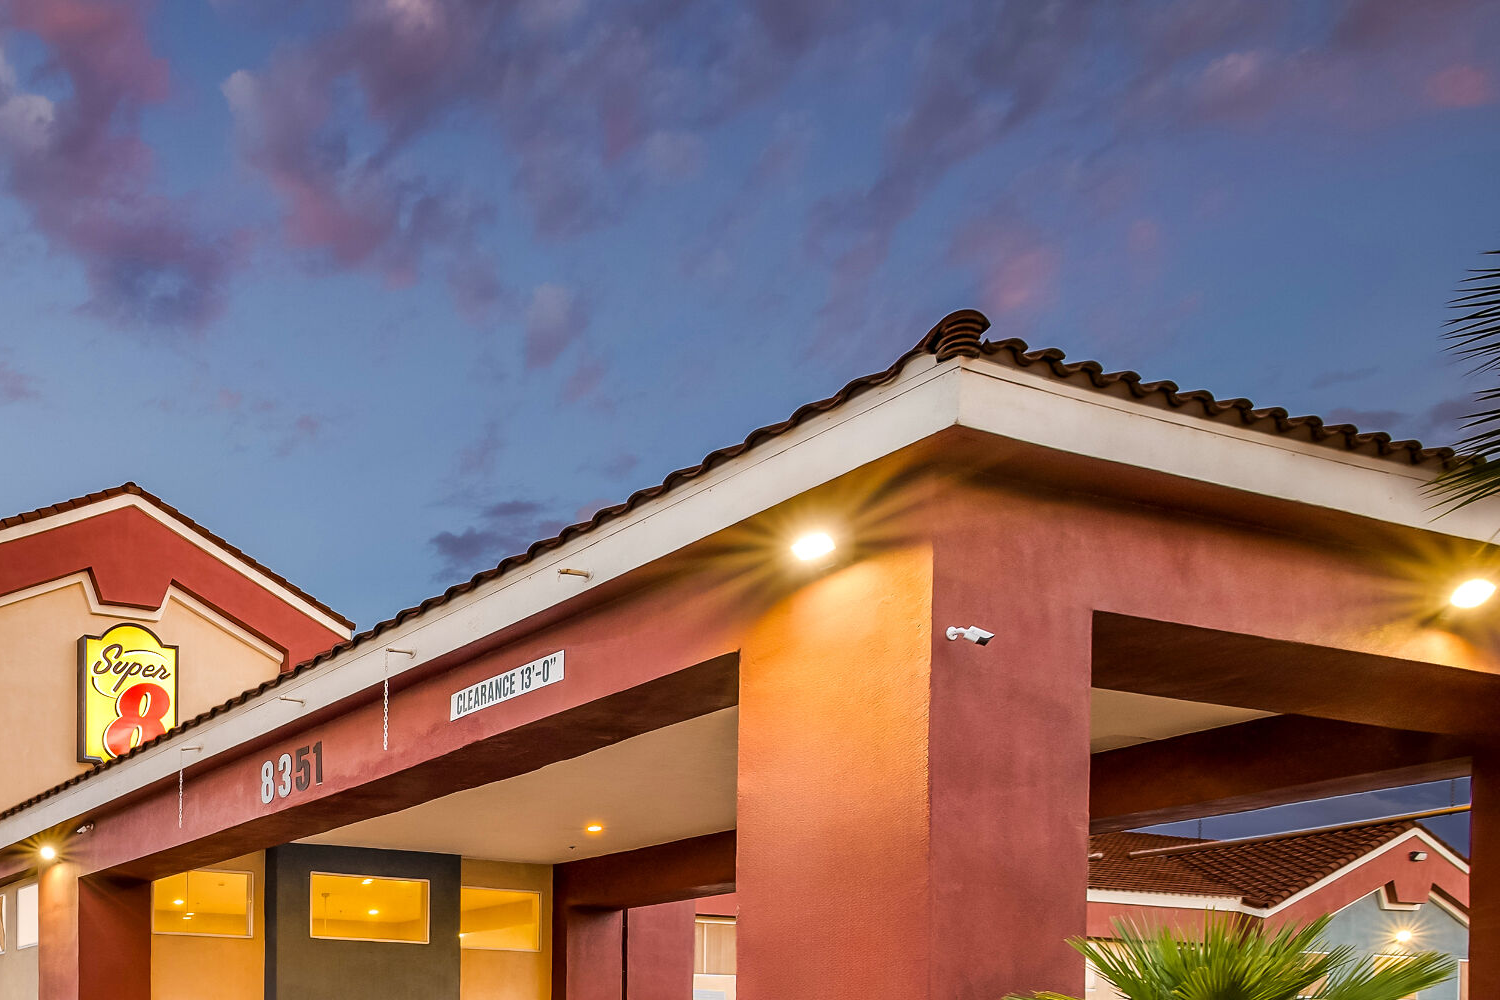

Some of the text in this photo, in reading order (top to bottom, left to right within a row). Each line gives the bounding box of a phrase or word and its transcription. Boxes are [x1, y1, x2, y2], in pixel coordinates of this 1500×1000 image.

[92, 643, 172, 693] Super
[456, 672, 516, 715] CLEARANCE
[102, 682, 171, 759] 8
[261, 740, 323, 805] 8351
